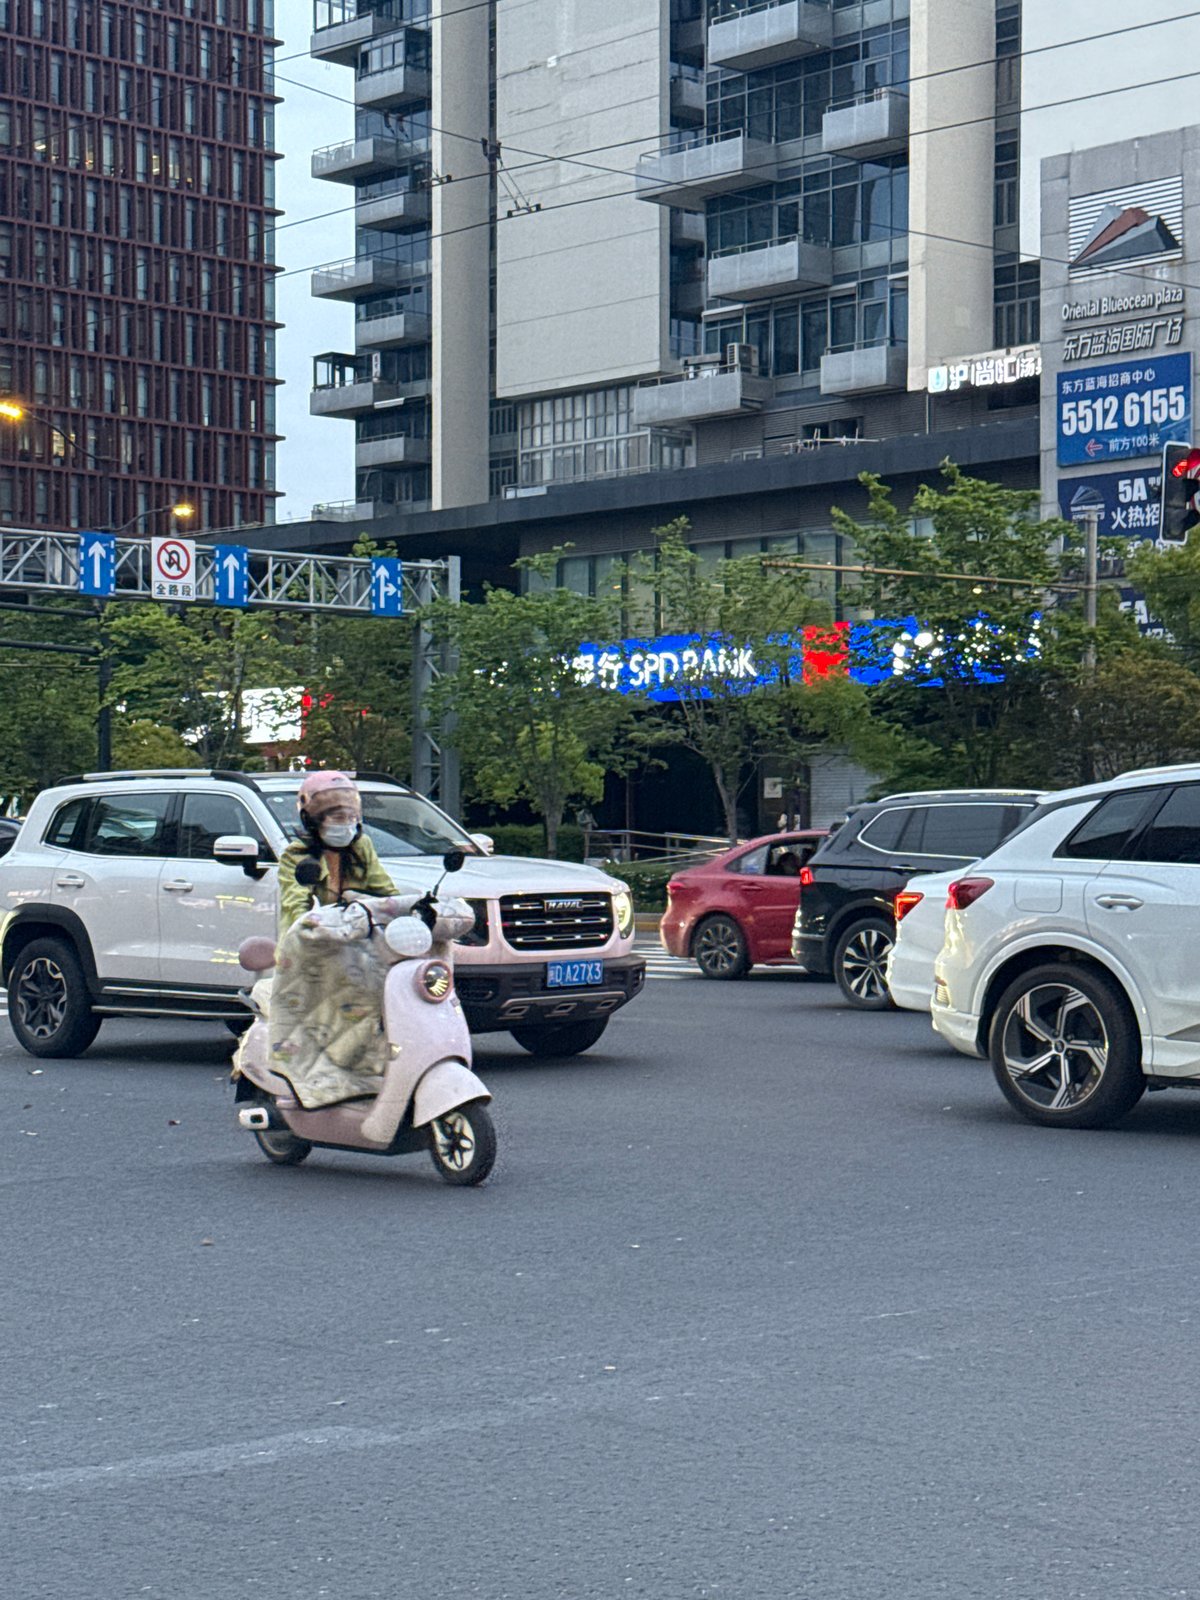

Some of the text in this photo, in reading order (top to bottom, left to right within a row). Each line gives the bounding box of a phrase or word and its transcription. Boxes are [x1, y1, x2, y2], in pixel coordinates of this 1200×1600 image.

[1062, 287, 1183, 320] Oriental Blueocean plaza
[1063, 317, 1182, 360] 东方蓝海国际广场
[1062, 368, 1156, 394] 东方蓝海招商中心
[1062, 385, 1185, 436] 5512 6155
[1108, 433, 1160, 452] 前方100米
[156, 584, 191, 596] 全路段
[629, 650, 680, 686] SPD
